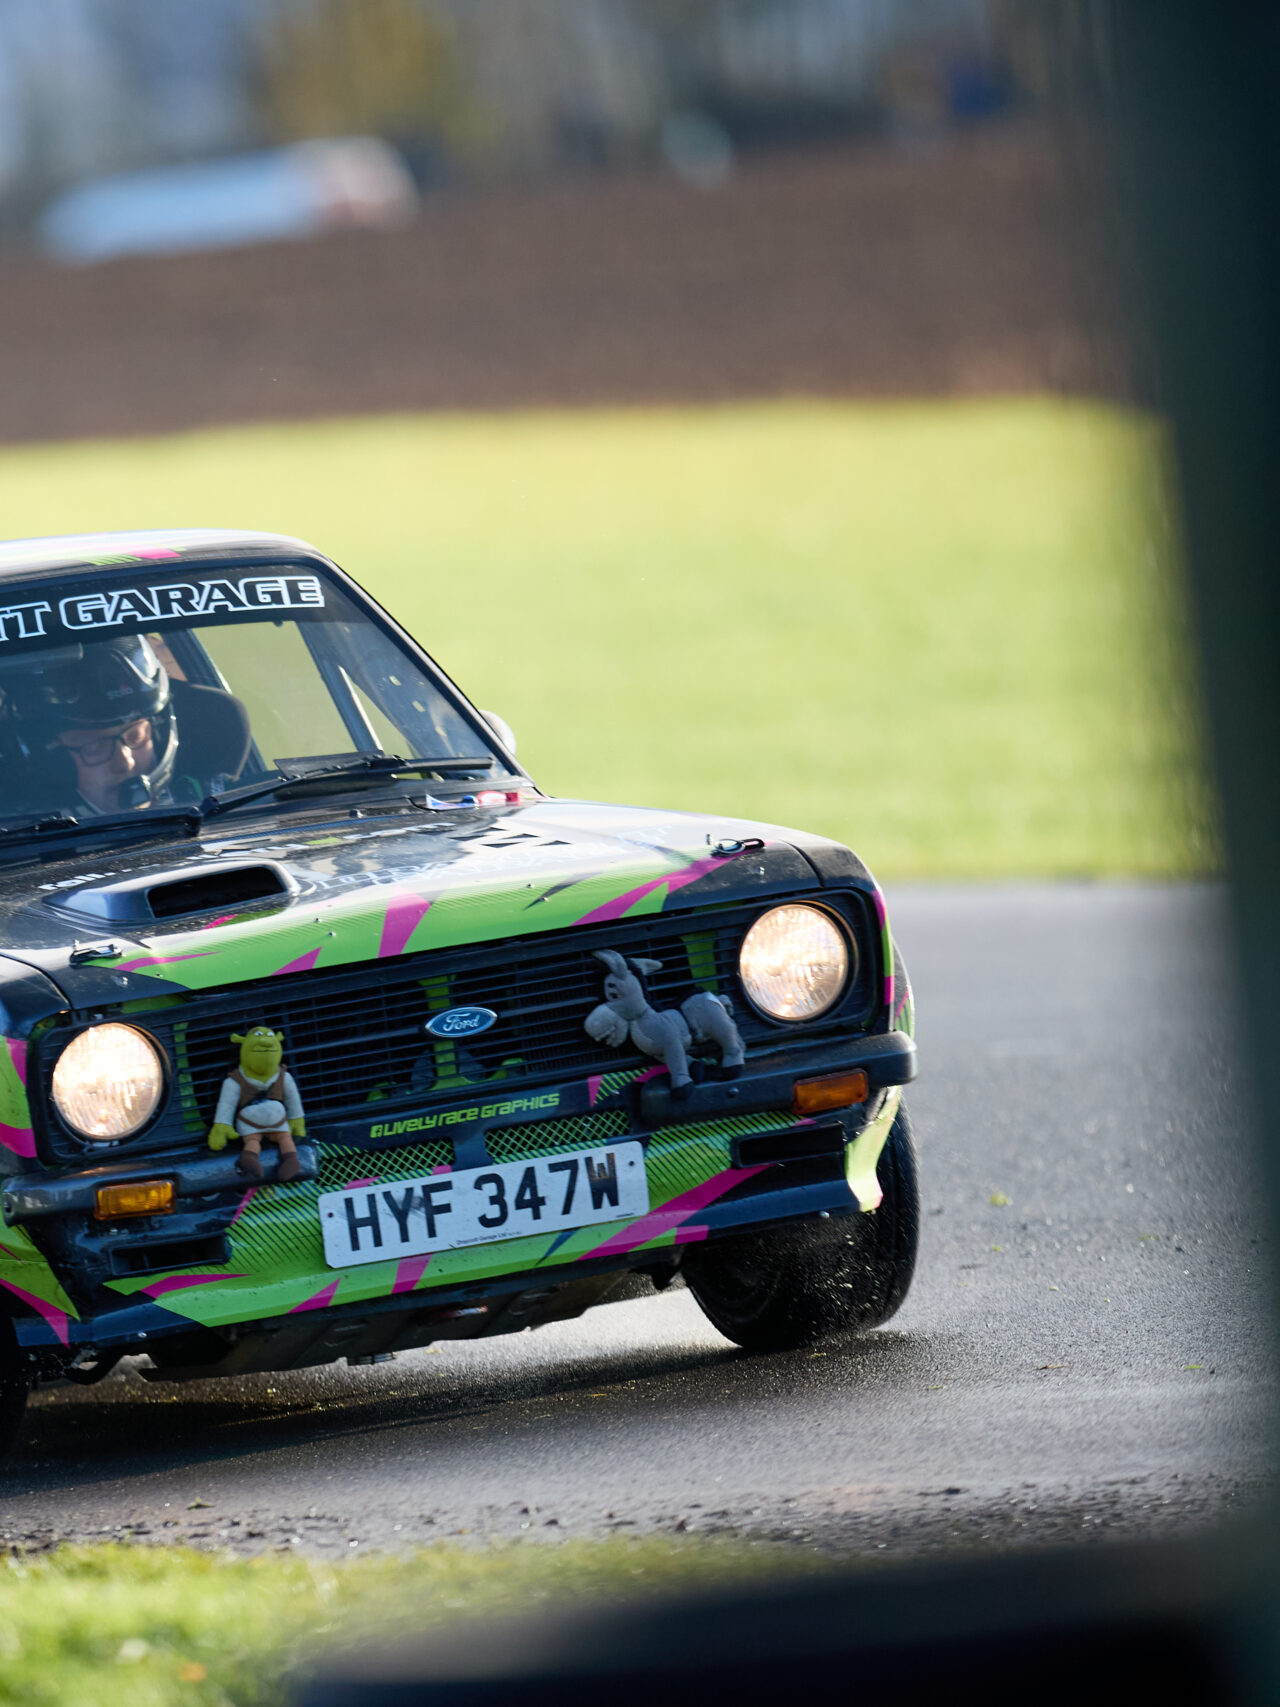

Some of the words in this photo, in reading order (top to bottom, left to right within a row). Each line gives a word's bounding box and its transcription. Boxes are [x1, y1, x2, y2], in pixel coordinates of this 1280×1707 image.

[59, 575, 325, 630] GARAGE
[442, 1012, 480, 1032] Ford
[344, 1180, 454, 1251] HYF
[473, 1152, 620, 1229] 347W
